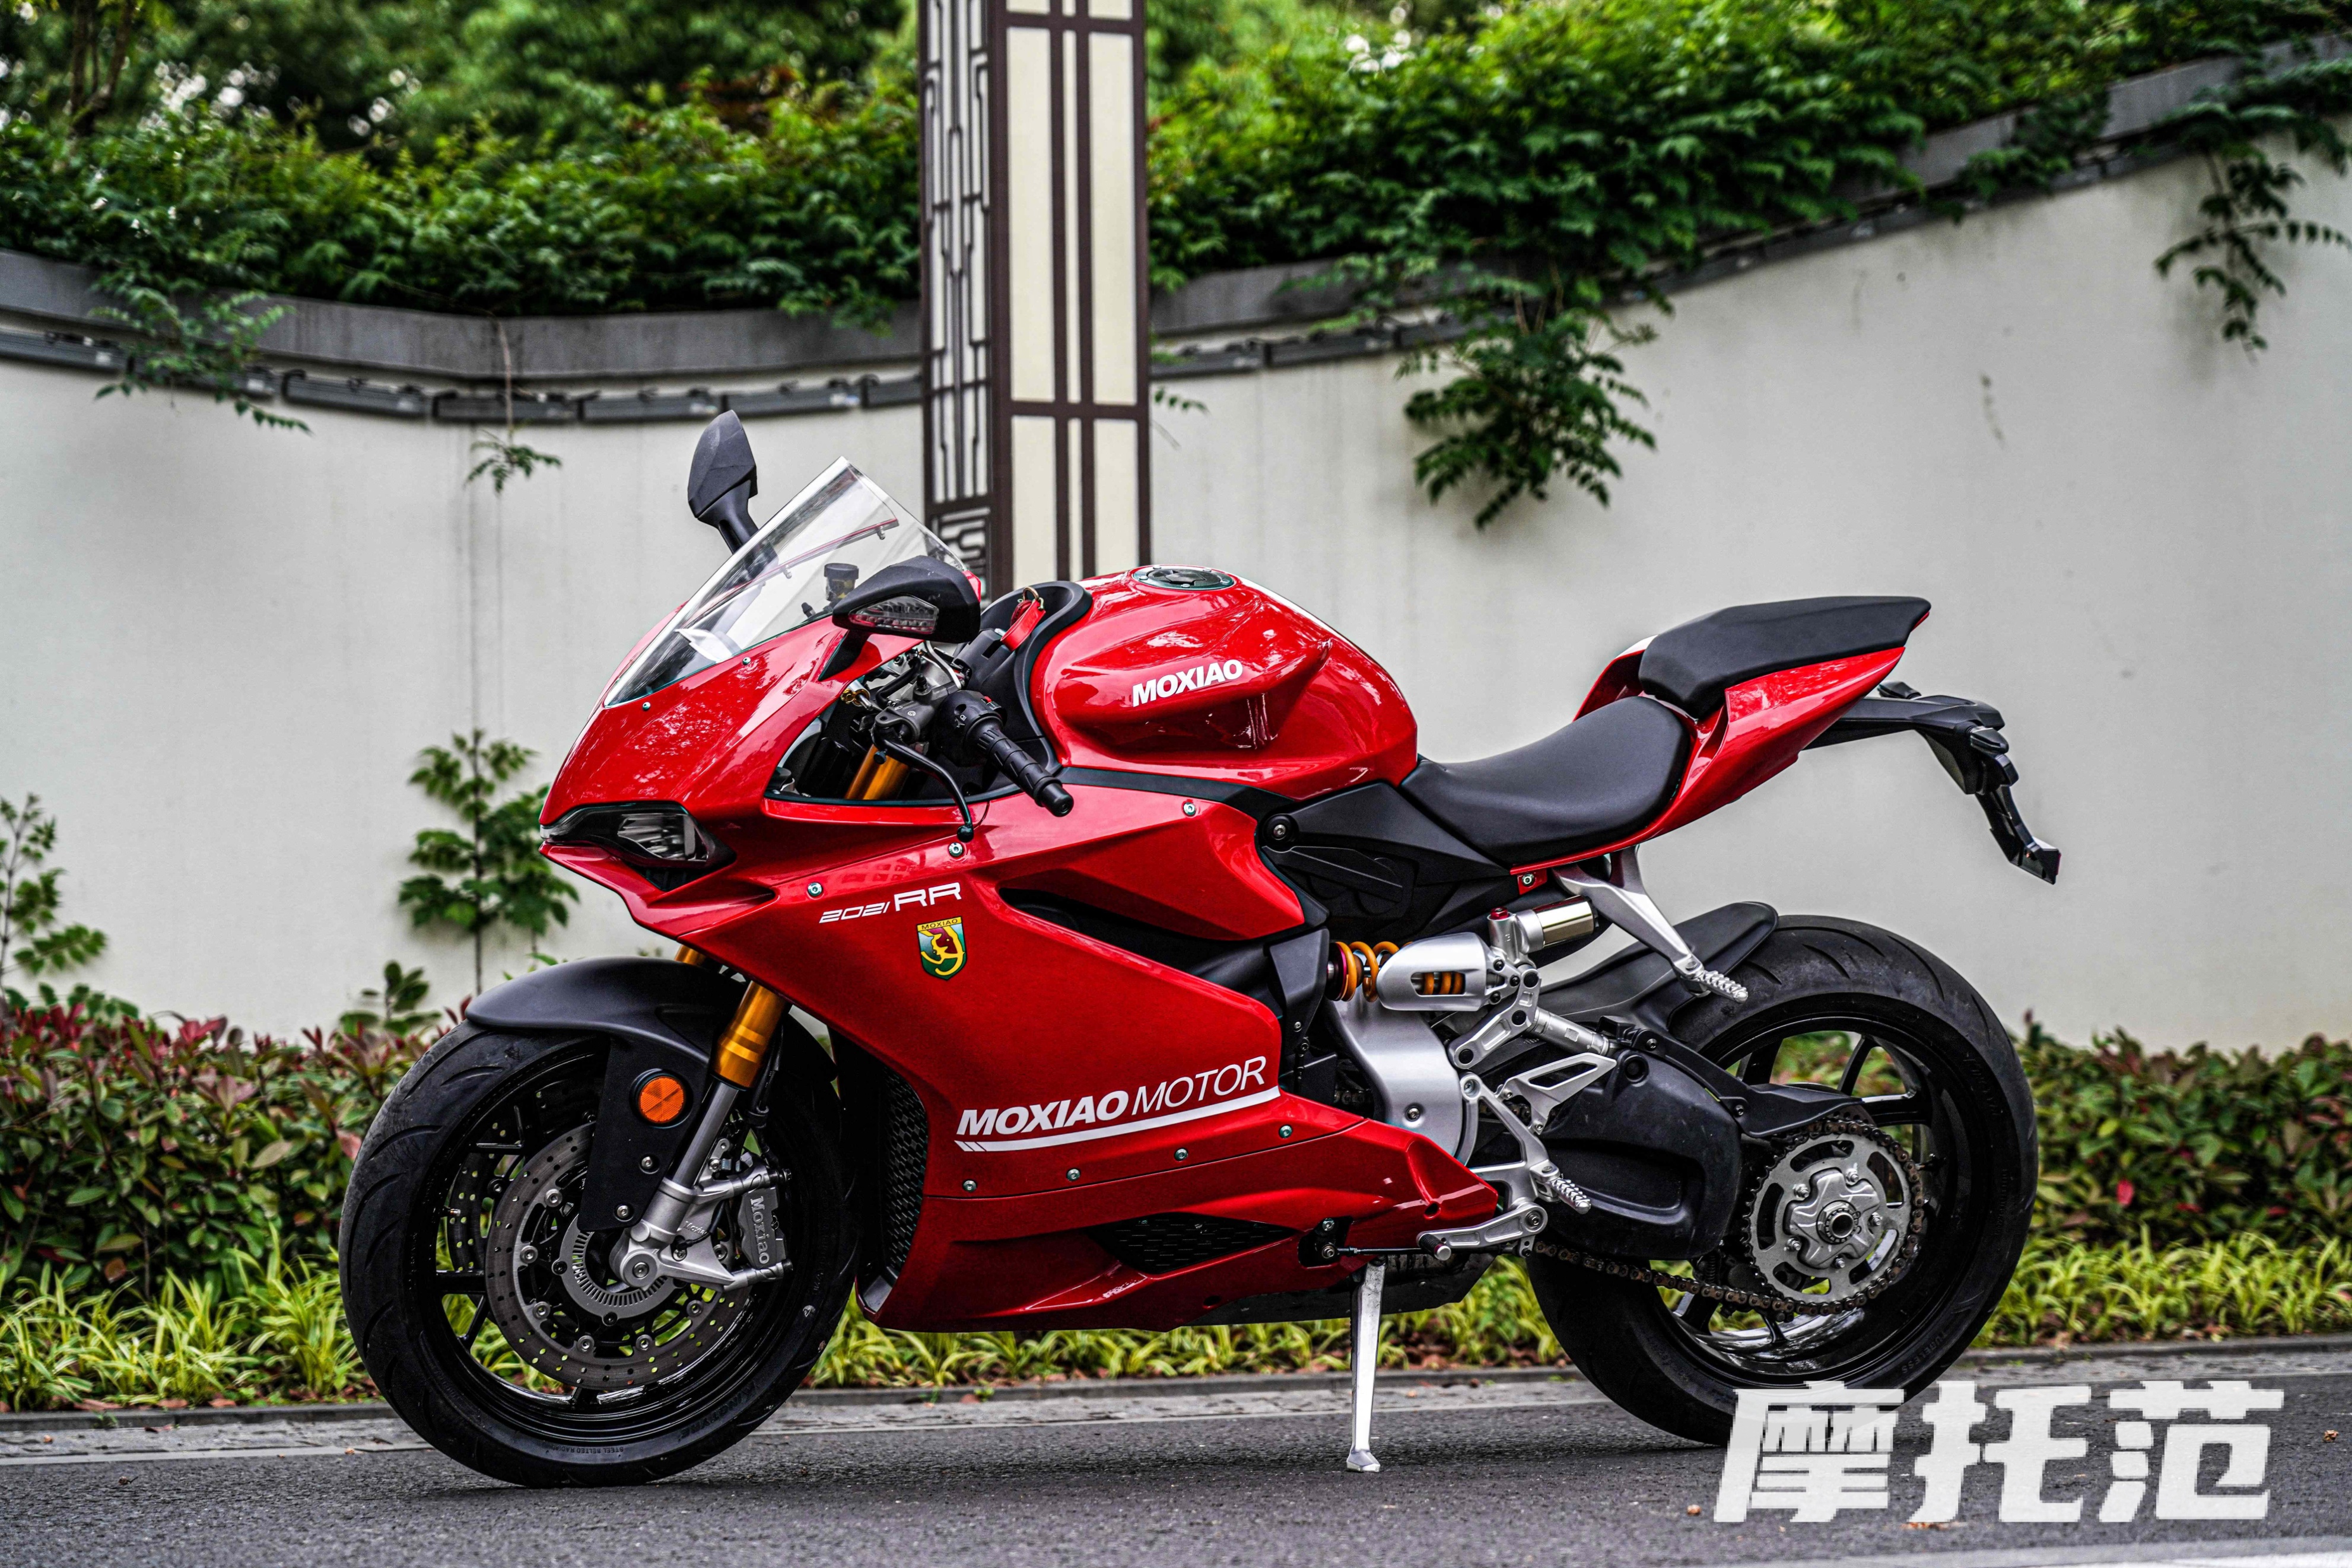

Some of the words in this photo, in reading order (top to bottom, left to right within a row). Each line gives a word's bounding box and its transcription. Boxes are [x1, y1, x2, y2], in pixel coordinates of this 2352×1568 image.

[1133, 660, 1243, 707] MOXIAO
[819, 901, 891, 924] 2021
[894, 882, 962, 911] RR
[921, 919, 958, 930] MOXIAO
[956, 1090, 1129, 1135] MOXIAO
[1131, 1056, 1266, 1115] MOTOR
[750, 1195, 770, 1264] Moxiao
